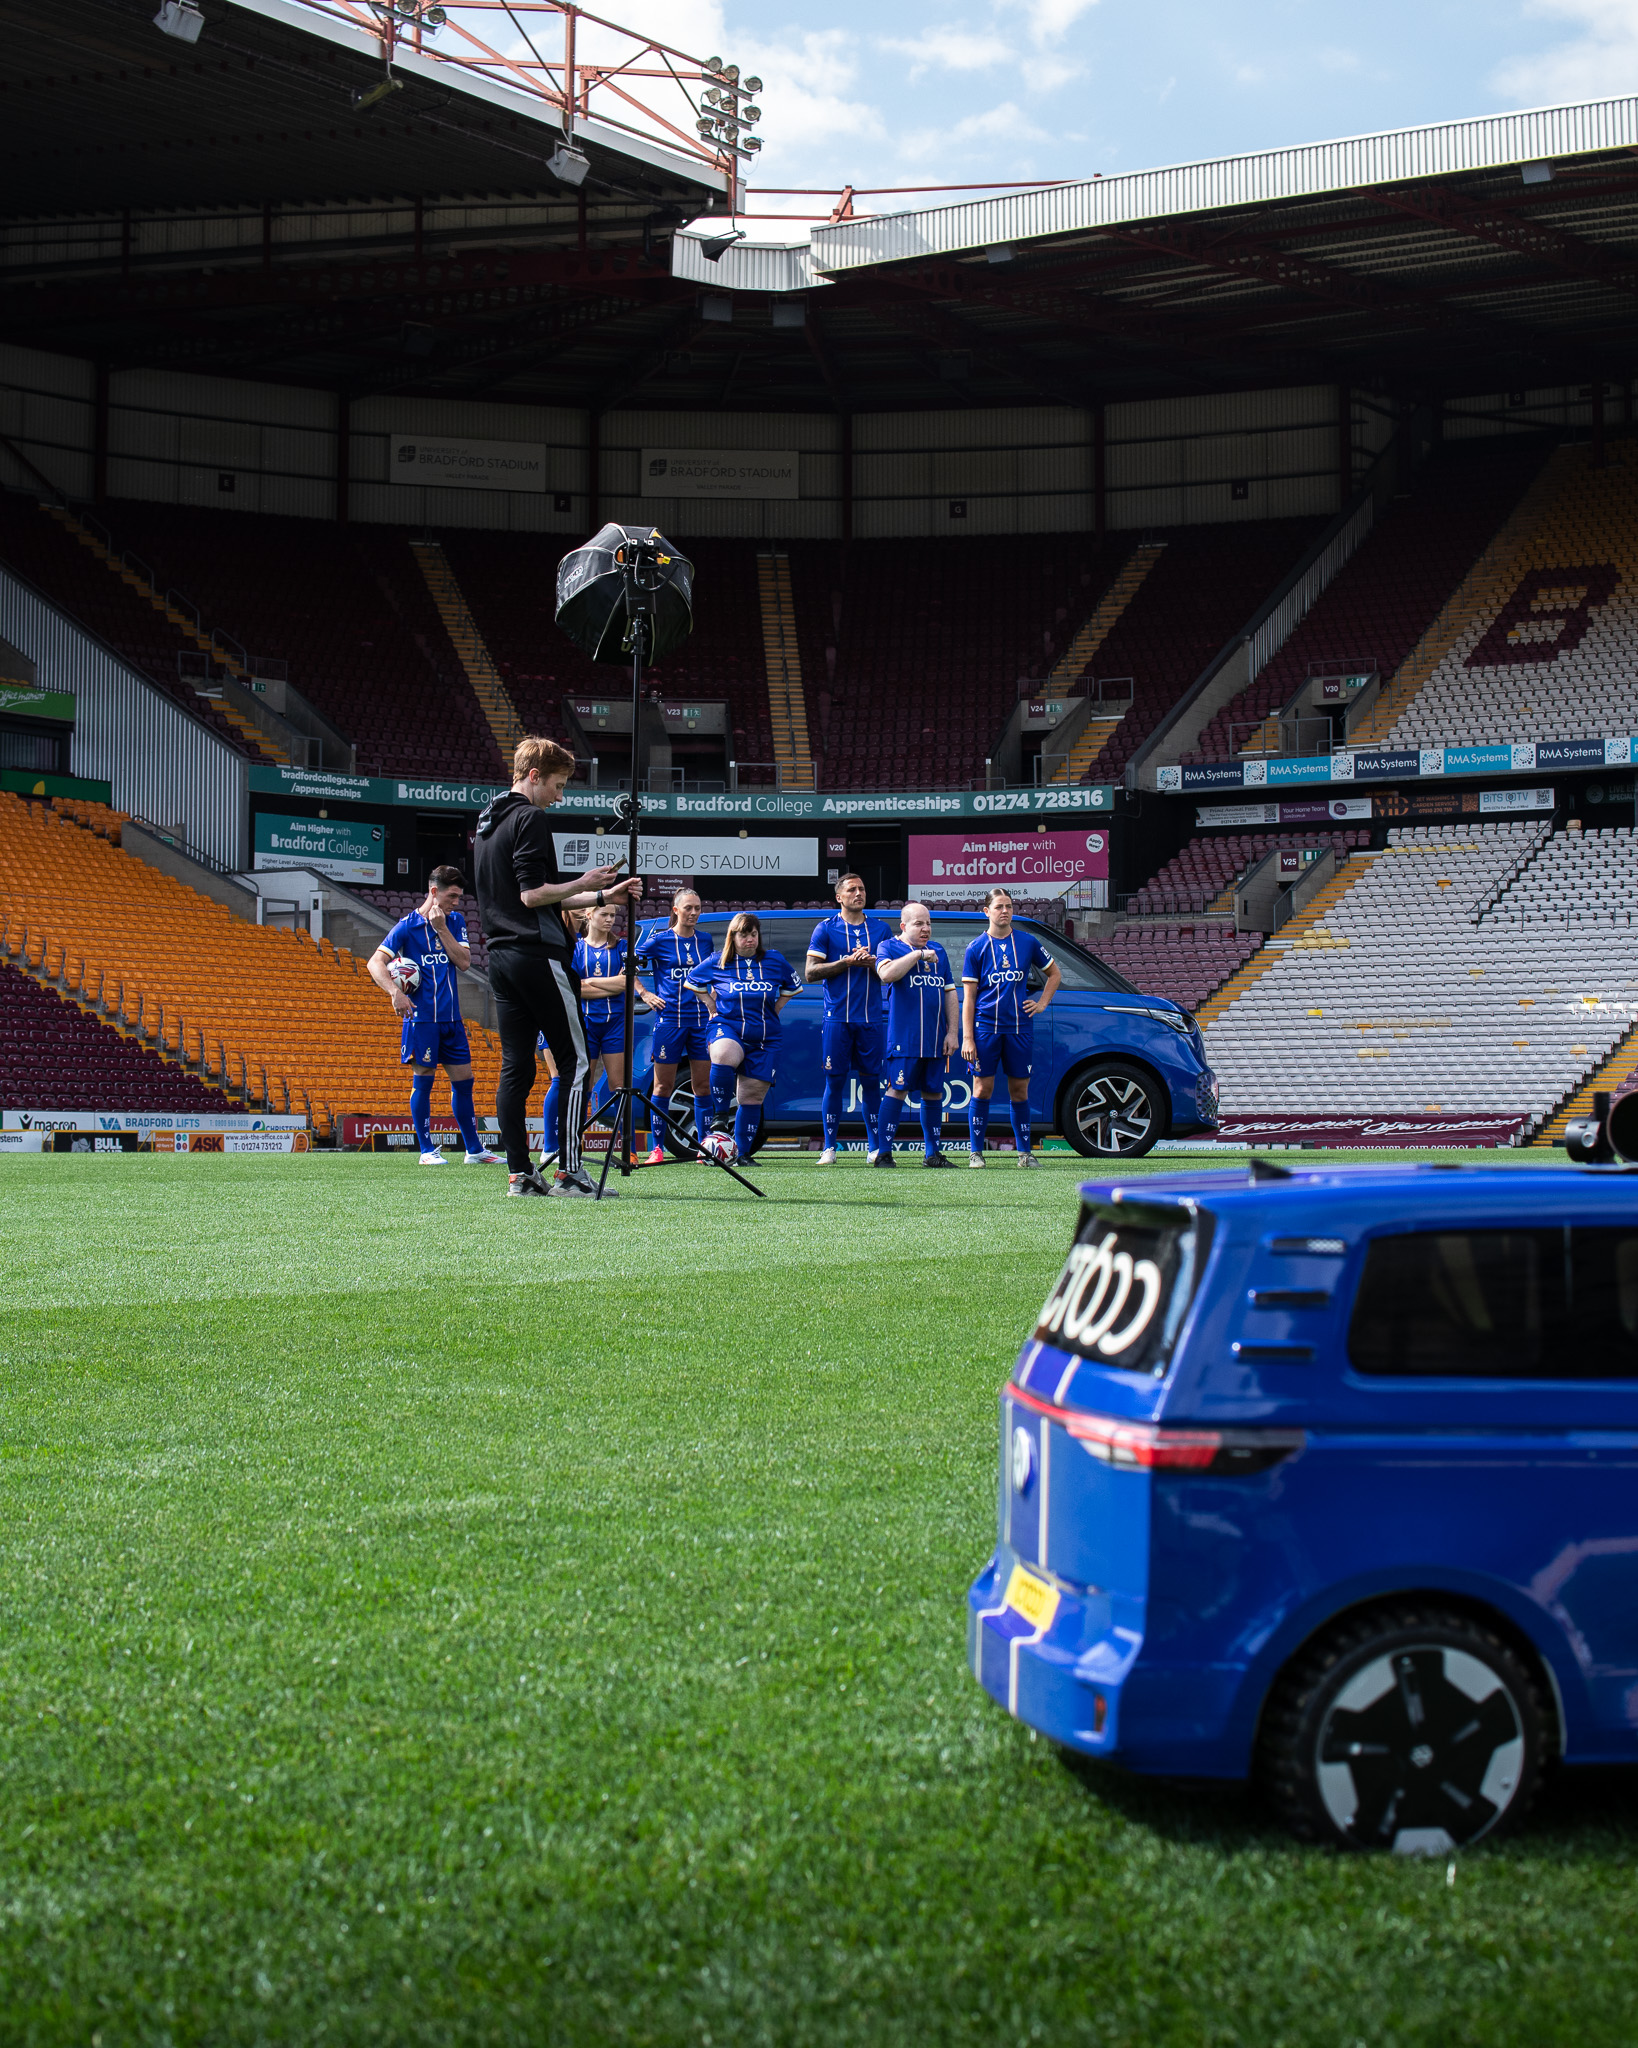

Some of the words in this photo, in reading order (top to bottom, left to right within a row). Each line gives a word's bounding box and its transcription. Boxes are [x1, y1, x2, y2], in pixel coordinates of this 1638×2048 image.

[419, 446, 461, 455] UNIVERSITY
[419, 453, 485, 468] BRADFORD
[487, 458, 539, 471] STADIUM
[670, 458, 712, 466] UNIVERSITY
[670, 466, 737, 478] BRADFORD
[739, 467, 792, 479] STADIUM
[666, 708, 681, 716] V23
[1447, 754, 1470, 765] RMA
[1471, 752, 1509, 764] Systems
[1539, 748, 1562, 760] RMA
[1563, 747, 1602, 760] Systems
[1270, 765, 1291, 776] RMA
[1292, 763, 1329, 776] Systems
[1357, 760, 1380, 770] RMA
[1381, 758, 1417, 770] Systems
[281, 769, 370, 787] bradfordcollege.ac.uk
[1184, 771, 1205, 781] RMA
[1206, 769, 1242, 781] Systems
[290, 782, 362, 799] /apprenticeships
[398, 783, 467, 802] Bradford
[470, 787, 497, 804] Coll
[676, 796, 751, 812] Bradford
[755, 796, 813, 816] College
[822, 797, 961, 814] Apprenticeships
[973, 793, 1030, 811] 01274
[1034, 789, 1104, 809] 728316
[290, 822, 307, 832] Aim
[307, 823, 334, 835] Higher
[335, 826, 352, 836] with
[271, 833, 326, 852] Bradford
[328, 838, 369, 859] College
[595, 840, 657, 851] UNIVESITY
[658, 842, 669, 851] of
[961, 841, 986, 853] Aim
[988, 839, 1029, 854] Higher
[1032, 838, 1056, 850] with
[262, 857, 279, 866] Higher
[291, 860, 330, 869] Apprenticeships
[700, 854, 780, 870] STADIUM
[932, 857, 1017, 877] Bradford
[1021, 855, 1085, 878] College
[1282, 858, 1297, 866] V25
[920, 890, 944, 898] Higher
[34, 1119, 77, 1132] macron
[125, 1117, 173, 1128] BRADFORD
[176, 1118, 200, 1128] LIFTS
[0, 1134, 23, 1143] stems
[94, 1137, 122, 1150] BULL
[225, 1133, 291, 1141] www.ask-the-office.co.uk
[387, 1133, 415, 1146] NORTHERN
[191, 1136, 222, 1152] ASK
[233, 1142, 241, 1151] T:
[241, 1142, 260, 1151] 01274
[260, 1142, 282, 1151] 731212
